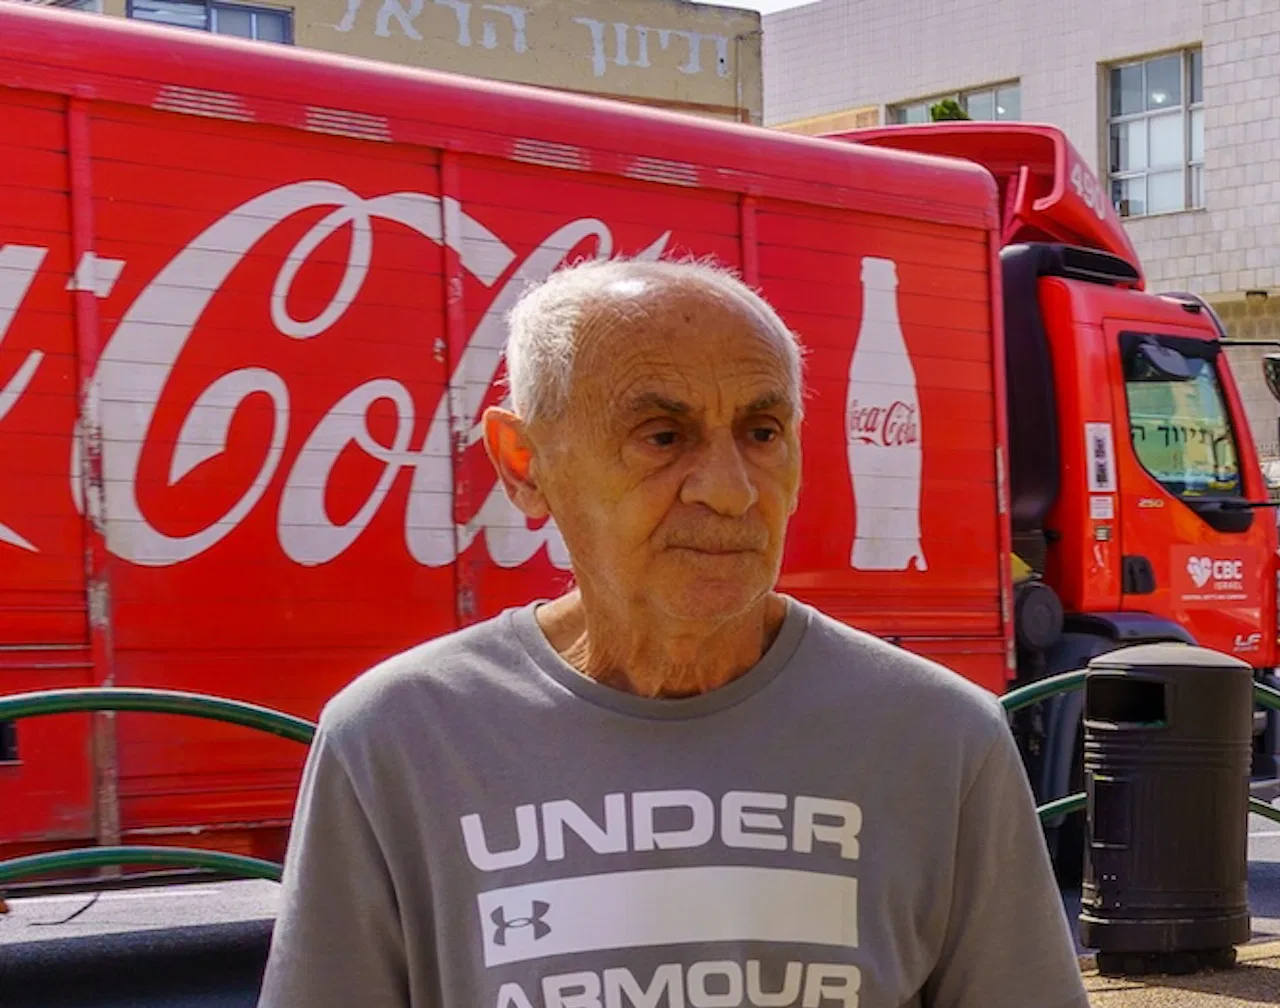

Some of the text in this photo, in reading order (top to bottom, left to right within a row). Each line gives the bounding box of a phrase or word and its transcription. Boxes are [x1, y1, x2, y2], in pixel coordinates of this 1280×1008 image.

[572, 16, 730, 77] תיווך
[1213, 559, 1243, 580] CBC
[460, 789, 862, 871] UNDER
